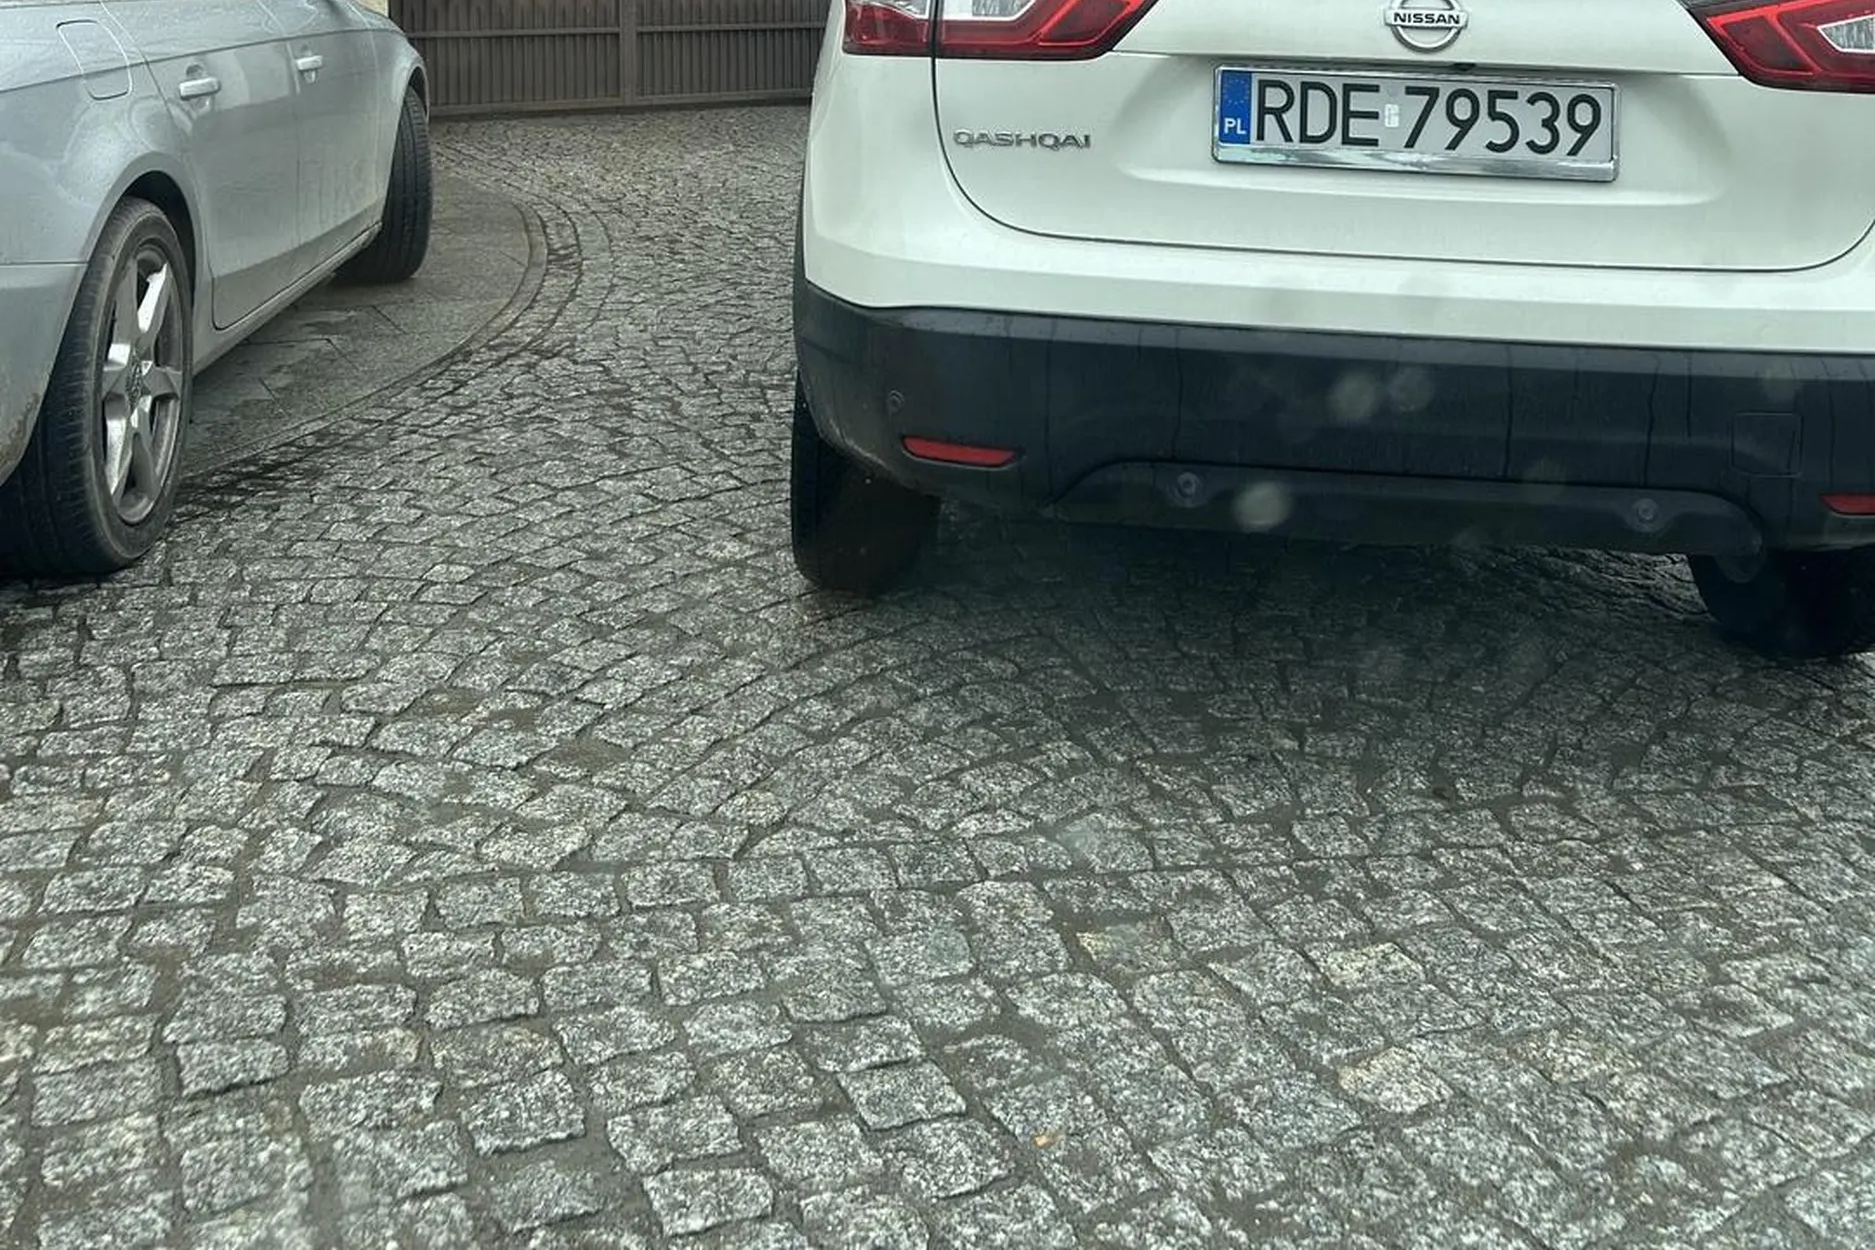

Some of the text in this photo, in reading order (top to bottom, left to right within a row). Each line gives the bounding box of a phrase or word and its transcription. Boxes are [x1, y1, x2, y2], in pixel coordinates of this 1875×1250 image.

[1393, 10, 1461, 26] NISSAN
[1223, 78, 1602, 158] PL RDE 79539
[953, 129, 1093, 152] QASHQAI
